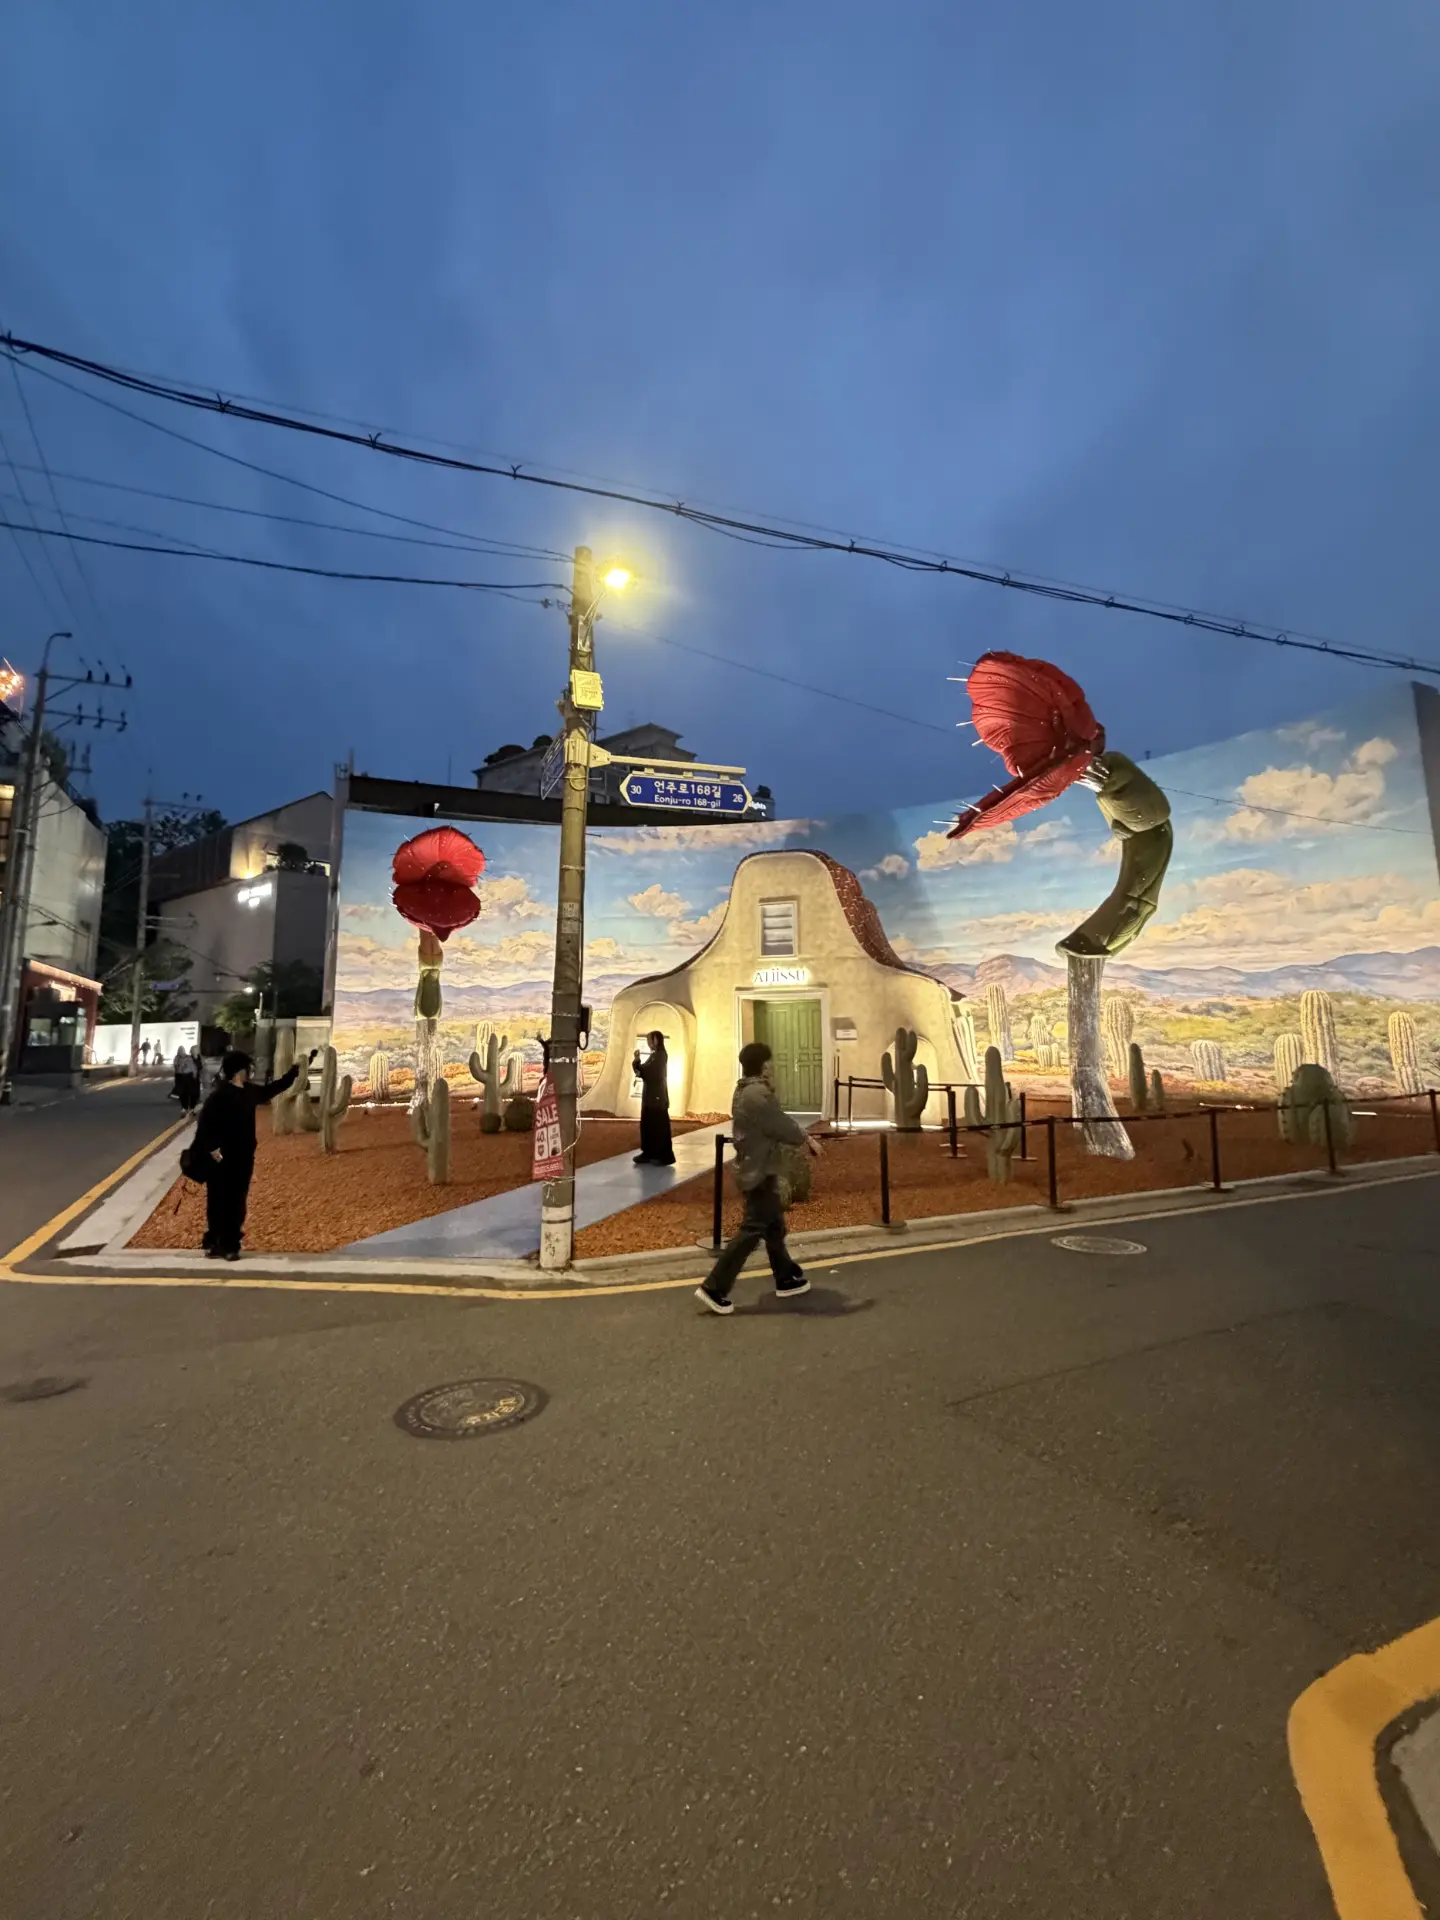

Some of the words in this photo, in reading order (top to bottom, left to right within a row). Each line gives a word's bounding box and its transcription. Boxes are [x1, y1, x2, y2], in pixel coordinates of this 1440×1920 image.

[630, 785, 642, 795] 30
[653, 780, 721, 798] 언주로168길
[654, 794, 691, 805] Eonju-ro
[693, 797, 721, 808] 168-gil
[732, 793, 744, 803] 26
[535, 1103, 559, 1128] SALE
